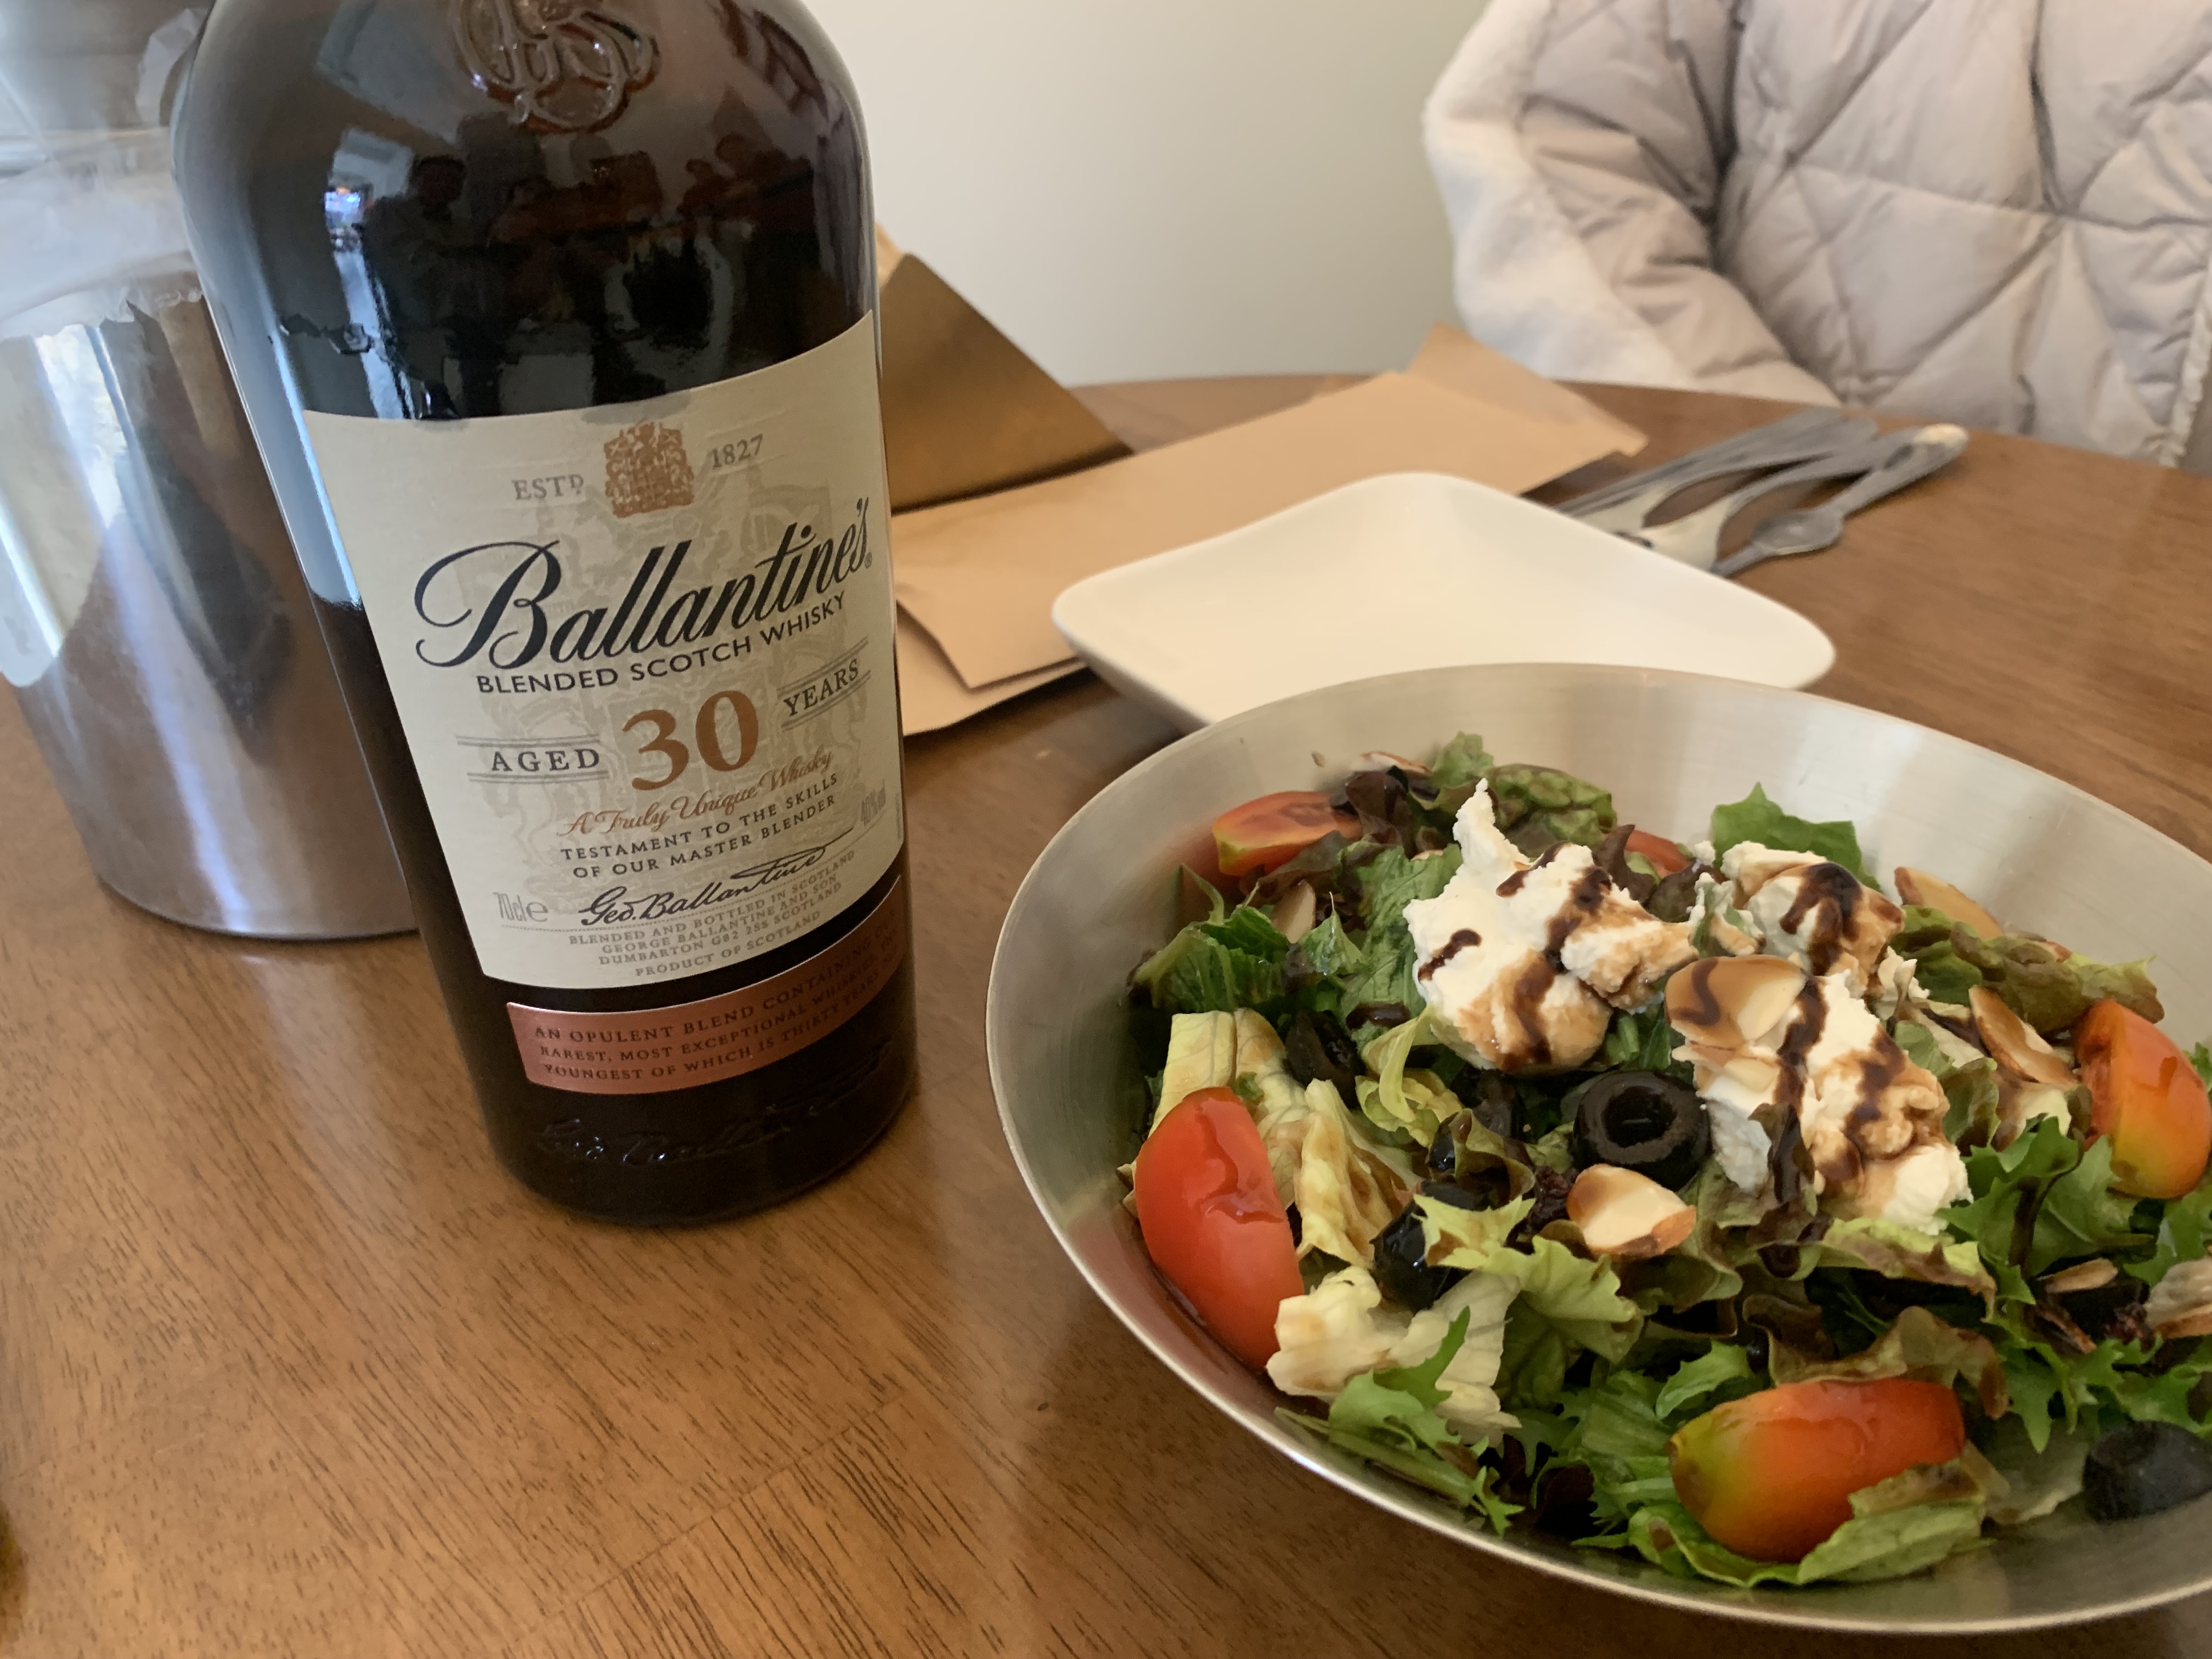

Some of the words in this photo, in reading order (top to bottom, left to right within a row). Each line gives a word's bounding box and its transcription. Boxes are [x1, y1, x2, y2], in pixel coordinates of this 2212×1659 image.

[713, 434, 764, 468] 1827
[414, 496, 869, 670] Ballantine's
[477, 668, 618, 693] BLENDED
[631, 636, 752, 681] SCOTCH
[760, 591, 845, 646] WHISKY
[492, 748, 600, 772] AGED
[622, 690, 759, 791] 30
[783, 658, 860, 718] YEARS
[558, 812, 594, 837] A
[594, 799, 670, 834] Truly
[671, 785, 758, 818] Unique
[759, 744, 833, 792] Whisky
[561, 832, 692, 861] TESTAMENT
[701, 822, 730, 839] TO
[739, 803, 777, 827] THE
[786, 773, 838, 810] SKILLS
[573, 866, 601, 878] OF
[612, 859, 660, 876] OUR
[670, 834, 752, 866] MASTER
[761, 795, 836, 838] BLENDER
[569, 930, 646, 945] BLENDED
[652, 922, 687, 936] AND
[693, 899, 766, 928] BOTTLED
[771, 889, 786, 902] IN
[792, 850, 855, 893] SCOTLAND
[598, 940, 704, 965] DUMBARTON
[712, 930, 740, 946] G82
[746, 919, 768, 935] 2SS
[774, 882, 842, 924] SCOTLAND
[602, 939, 671, 954] GEORGE
[677, 906, 775, 943] BALLANTINE
[780, 890, 808, 910] AND
[812, 874, 837, 893] SON
[635, 954, 714, 977] PRODUCT
[720, 946, 741, 958] OF
[747, 910, 820, 950] SCOTLAND
[535, 1026, 561, 1040] AN
[569, 1025, 674, 1043] OPULENT
[683, 1005, 754, 1035] BLEND
[762, 936, 872, 1011] CONTAINING
[539, 1046, 612, 1062] RAREST,
[620, 1047, 673, 1062] MOST
[682, 1002, 807, 1055] EXCEPTIONAL
[543, 1063, 642, 1080] YOUNGEST
[651, 1065, 676, 1078] OF
[684, 1047, 751, 1074] WHICH
[758, 1035, 775, 1052] IS
[781, 1002, 839, 1042] THIRTY
